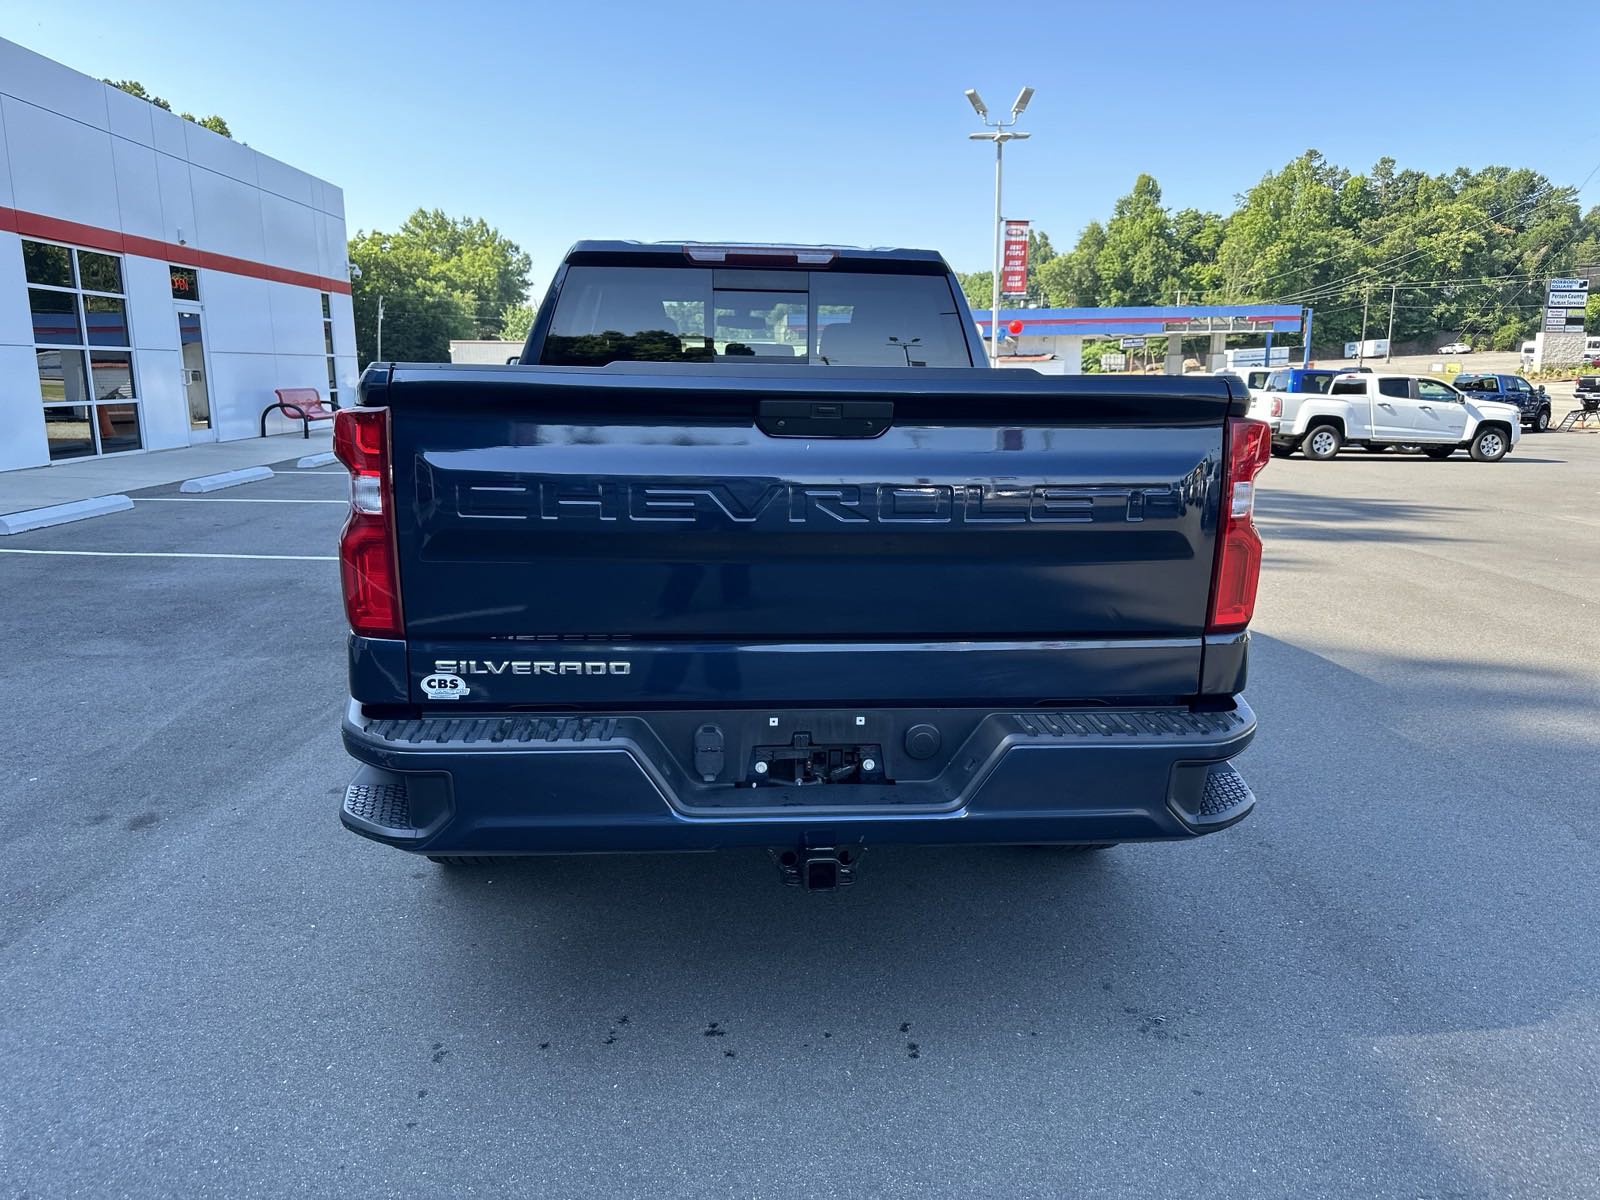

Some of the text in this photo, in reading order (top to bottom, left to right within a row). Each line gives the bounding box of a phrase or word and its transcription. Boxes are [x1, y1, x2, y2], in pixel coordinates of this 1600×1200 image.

[171, 278, 189, 291] OPEN
[456, 482, 1176, 523] CHEVROLET
[434, 660, 631, 675] SILVERADO
[426, 678, 459, 689] CBS
